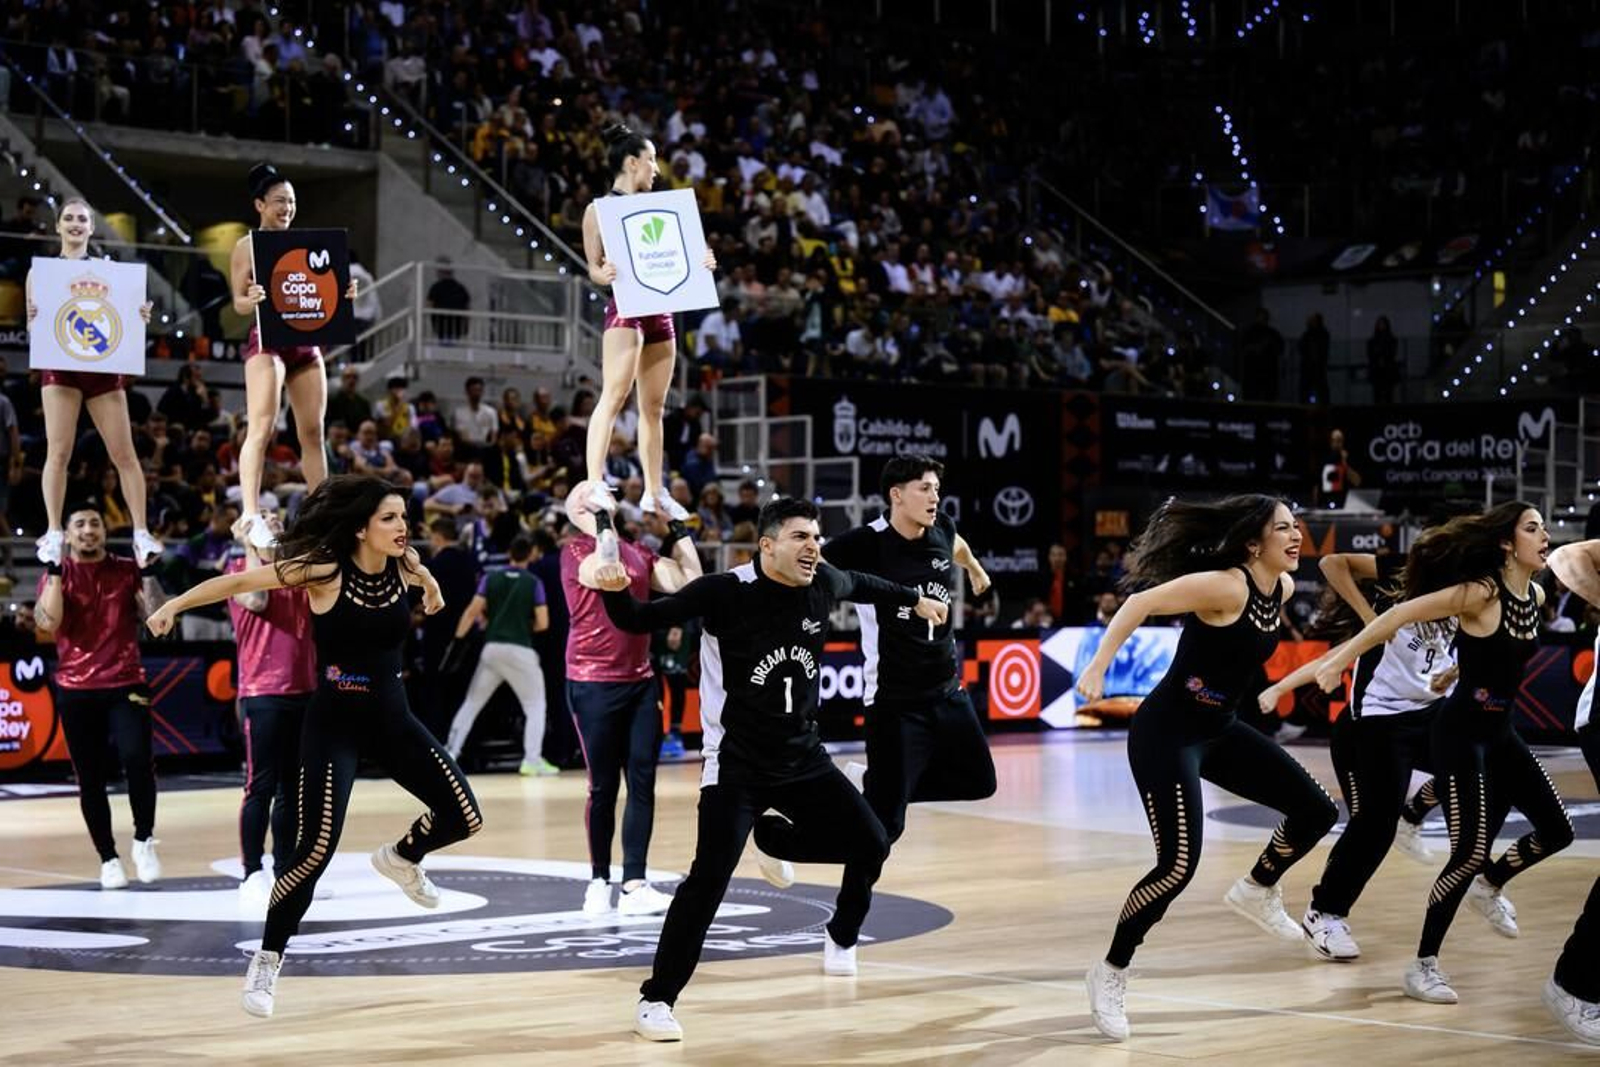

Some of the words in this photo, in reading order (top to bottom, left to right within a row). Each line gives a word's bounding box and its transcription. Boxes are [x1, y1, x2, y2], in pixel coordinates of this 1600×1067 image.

[288, 272, 307, 282] acb
[282, 281, 317, 296] Copa
[300, 295, 322, 310] Rey
[857, 416, 912, 437] Cabildo
[914, 420, 932, 438] de
[1383, 419, 1422, 440] acb
[857, 436, 893, 455] Gran
[895, 438, 948, 457] Canaria
[1444, 439, 1475, 457] del
[750, 646, 787, 685] DREAM
[1421, 649, 1436, 674] 9
[819, 664, 864, 701] pa
[783, 677, 793, 713] 1
[0, 701, 23, 720] pa
